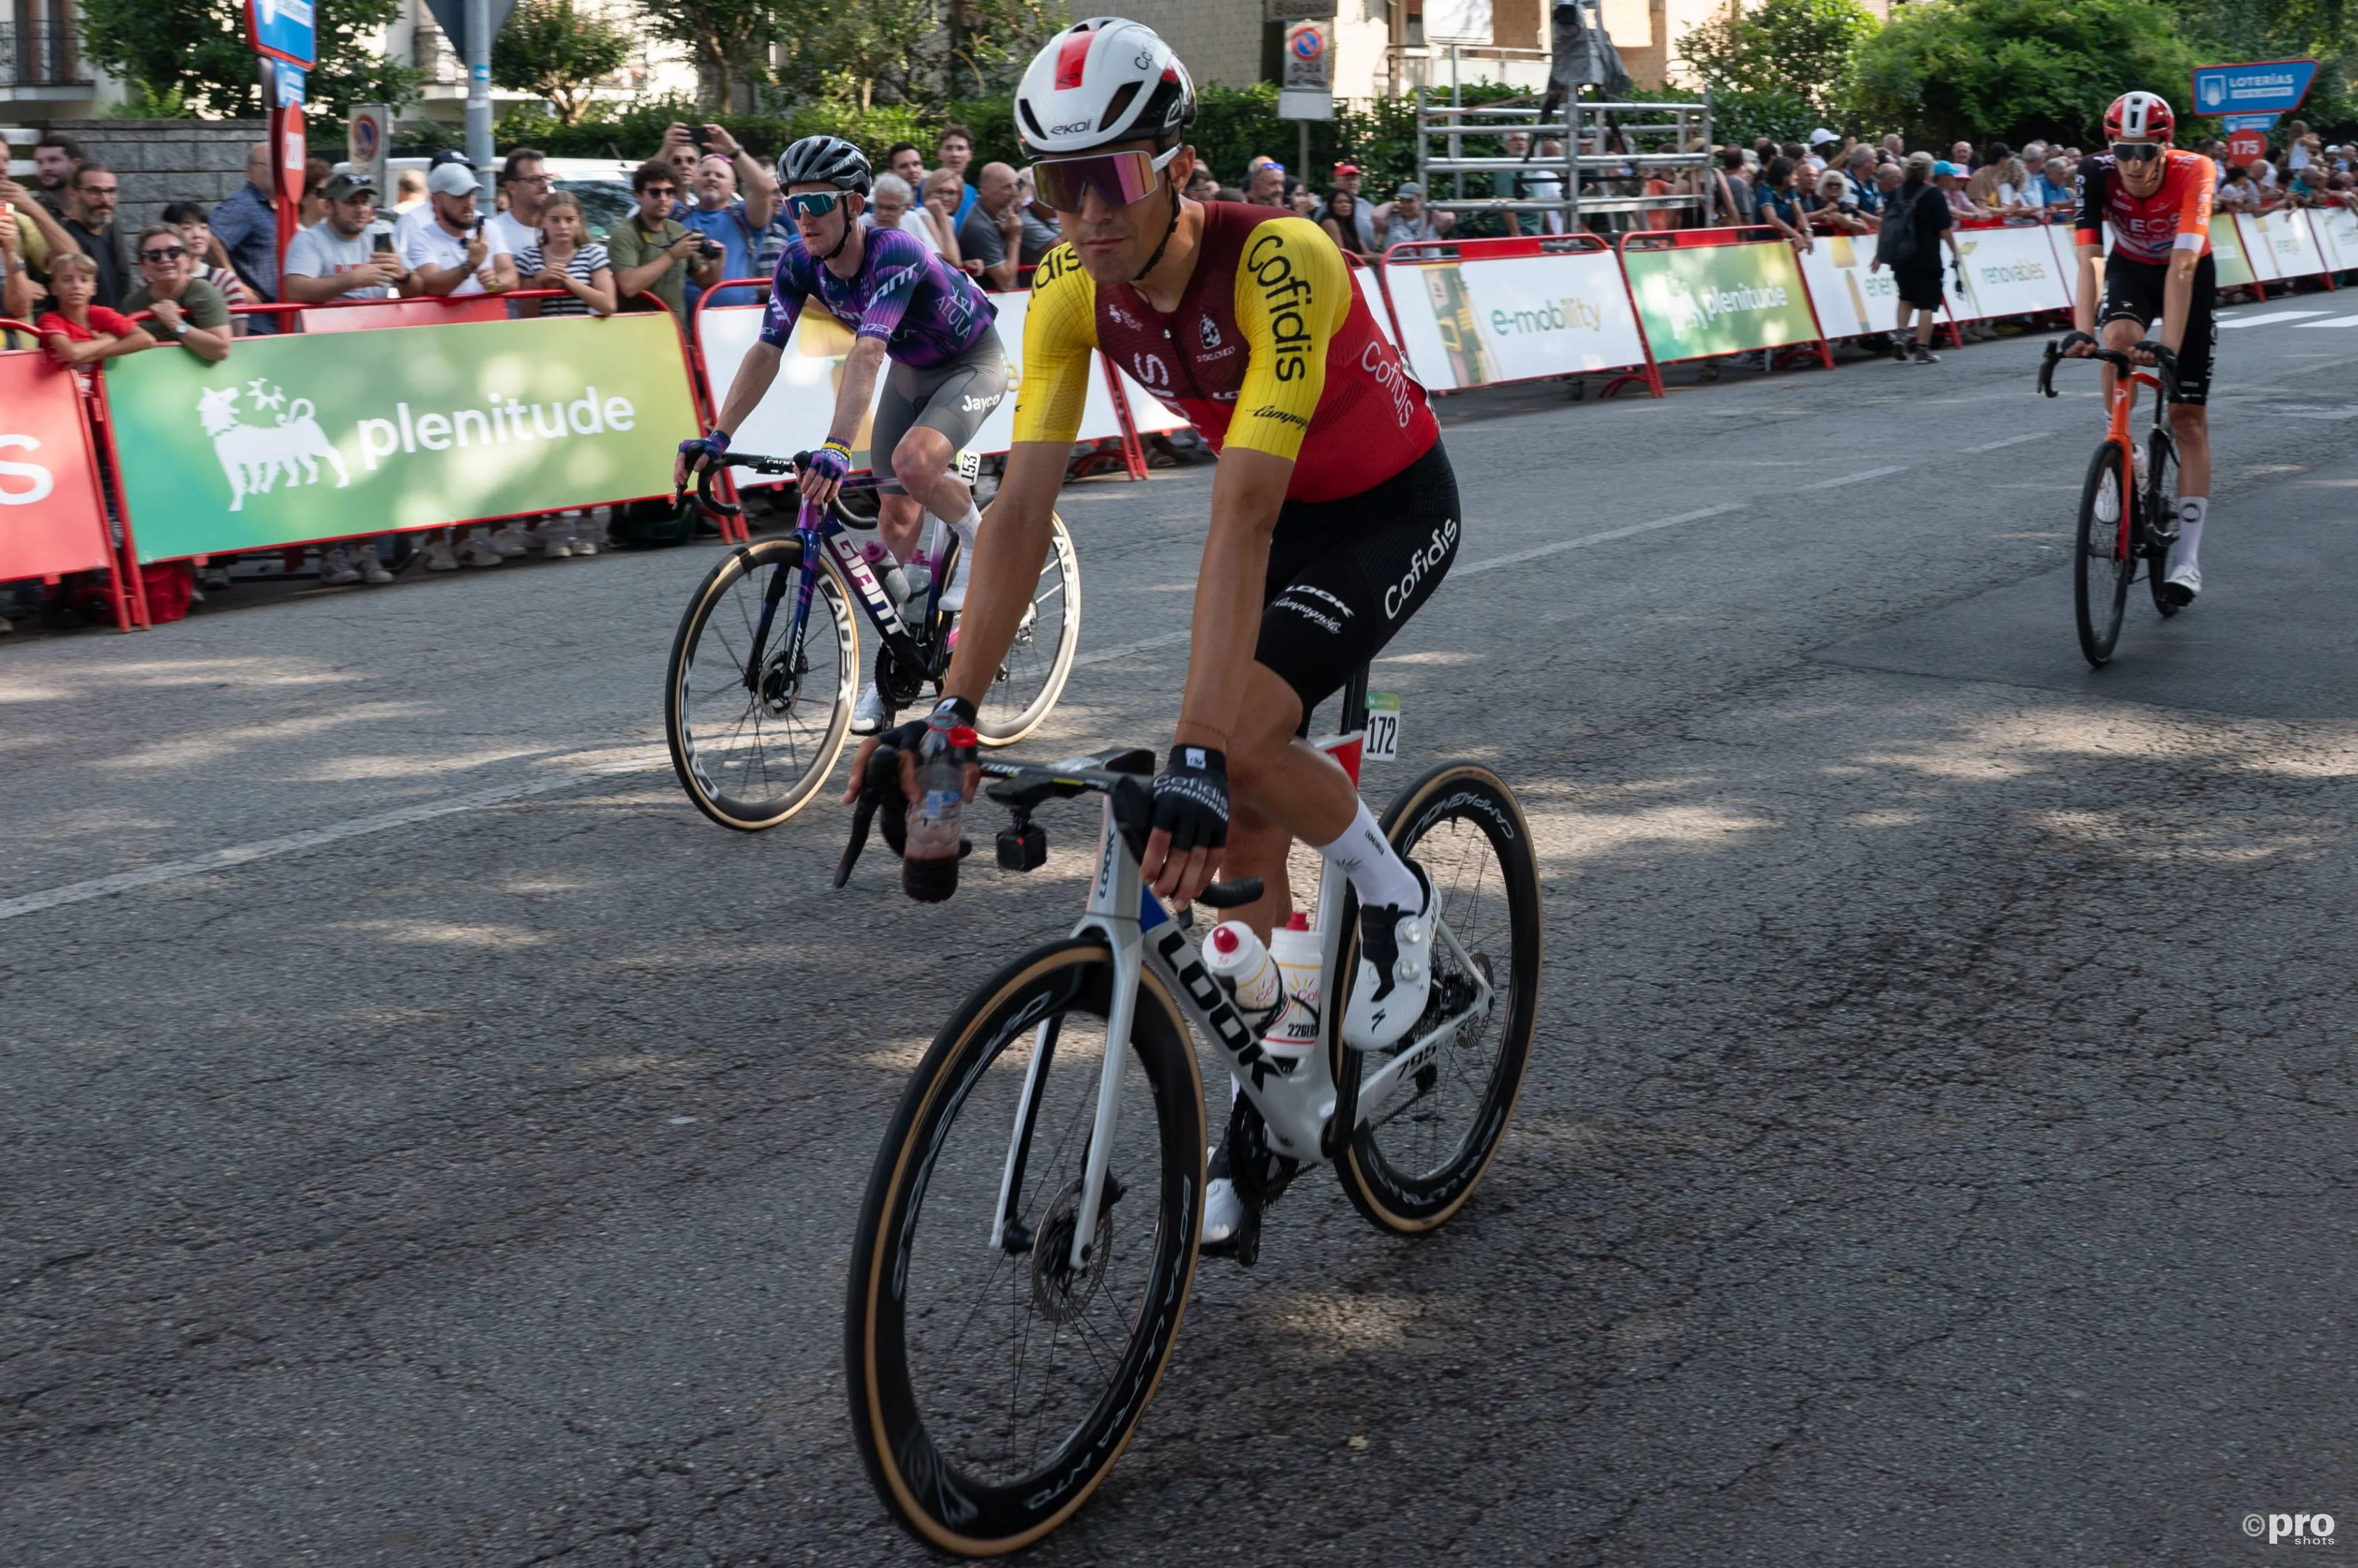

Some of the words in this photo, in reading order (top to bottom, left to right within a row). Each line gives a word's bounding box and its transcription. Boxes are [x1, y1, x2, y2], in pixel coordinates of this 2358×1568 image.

[2229, 73, 2294, 88] LOTERÍAS
[2231, 139, 2260, 155] 175
[2074, 174, 2086, 221] INEOS
[934, 296, 972, 344] ALULA
[1248, 235, 1312, 382] Cofidis
[1492, 298, 1601, 335] e-mobility
[1700, 281, 1789, 321] plenitude
[962, 393, 1001, 413] Jayco
[1361, 341, 1414, 428] Cofidis
[357, 386, 636, 470] plenitude
[961, 454, 978, 483] 153
[830, 531, 911, 637] GIANT
[1384, 518, 1457, 620] Cofidis
[1285, 584, 1355, 618] LOOK
[790, 621, 803, 673] GIANT
[817, 573, 854, 708] CADEX
[1366, 716, 1396, 754] 172
[1099, 828, 1116, 899] LOOK
[1158, 931, 1282, 1093] LOOK
